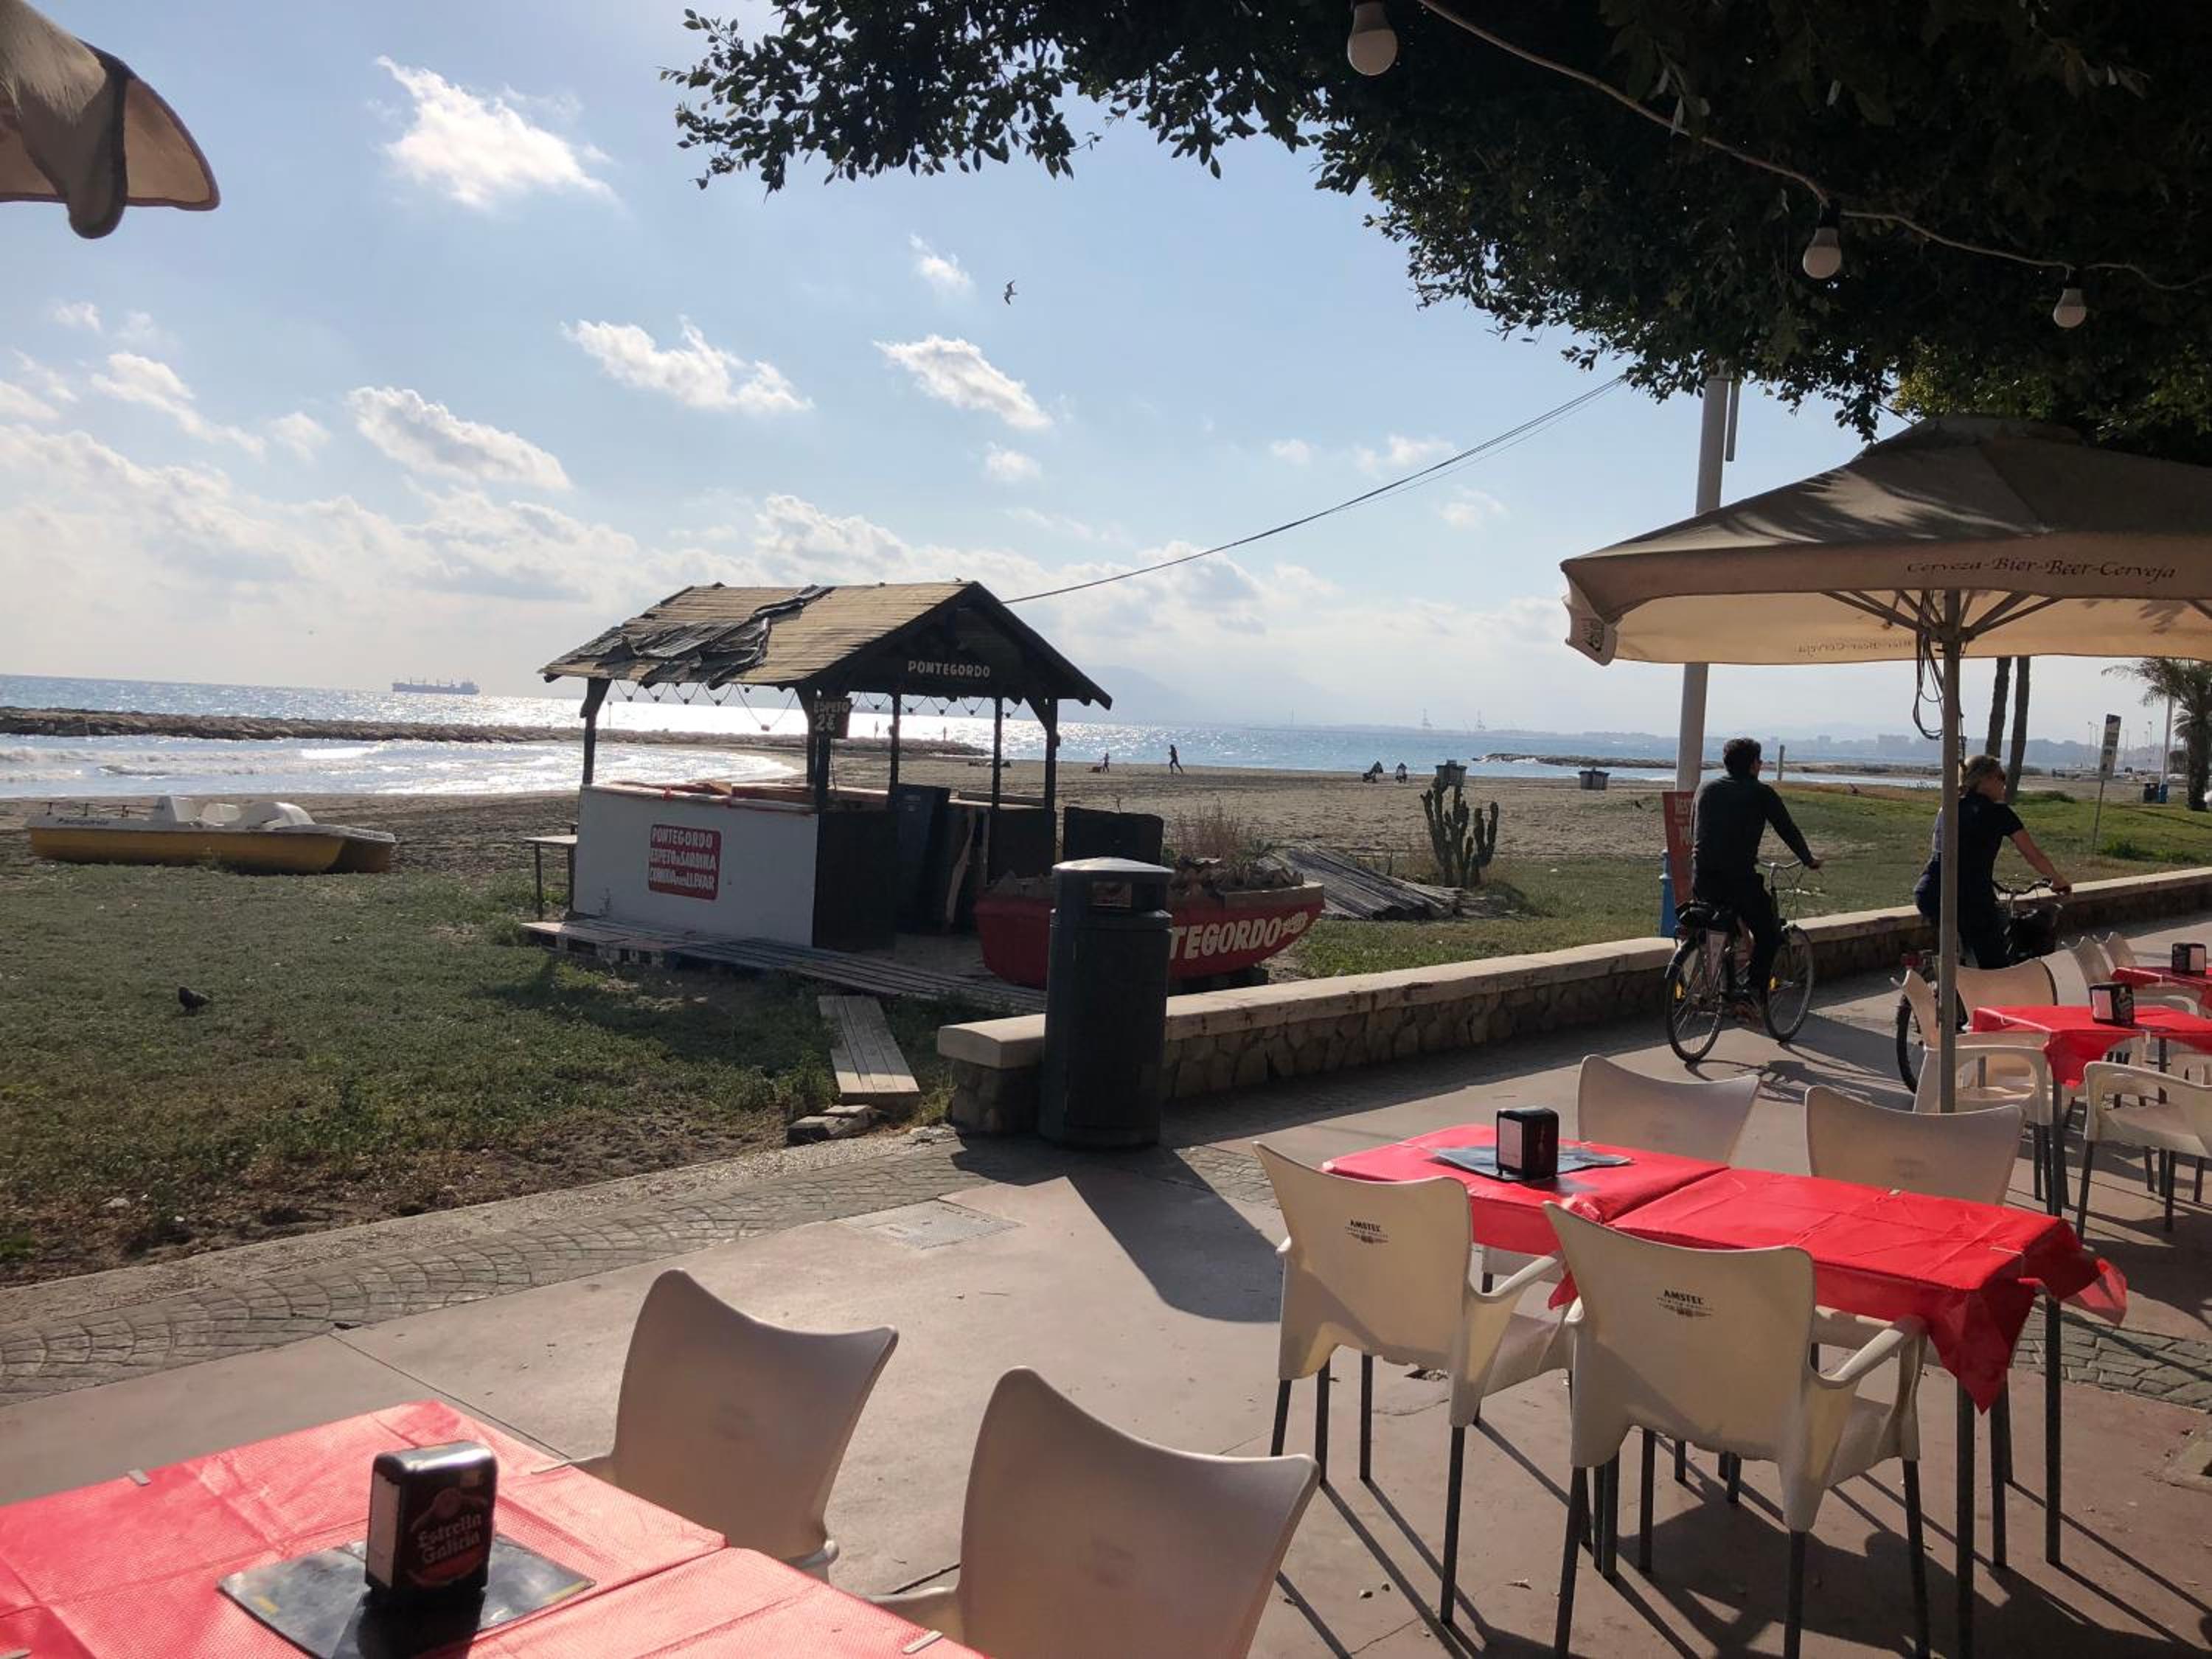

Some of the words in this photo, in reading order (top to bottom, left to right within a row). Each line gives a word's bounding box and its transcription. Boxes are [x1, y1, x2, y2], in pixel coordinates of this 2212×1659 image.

[908, 660, 990, 678] PONTEGORDO
[651, 827, 714, 849] PONTEGORDO
[1169, 917, 1282, 959] TEGORDO
[1350, 1220, 1381, 1232] AMSTEL
[1663, 1290, 1705, 1304] AMSTEL
[417, 1513, 481, 1548] Estrella
[422, 1531, 481, 1564] Galicia
